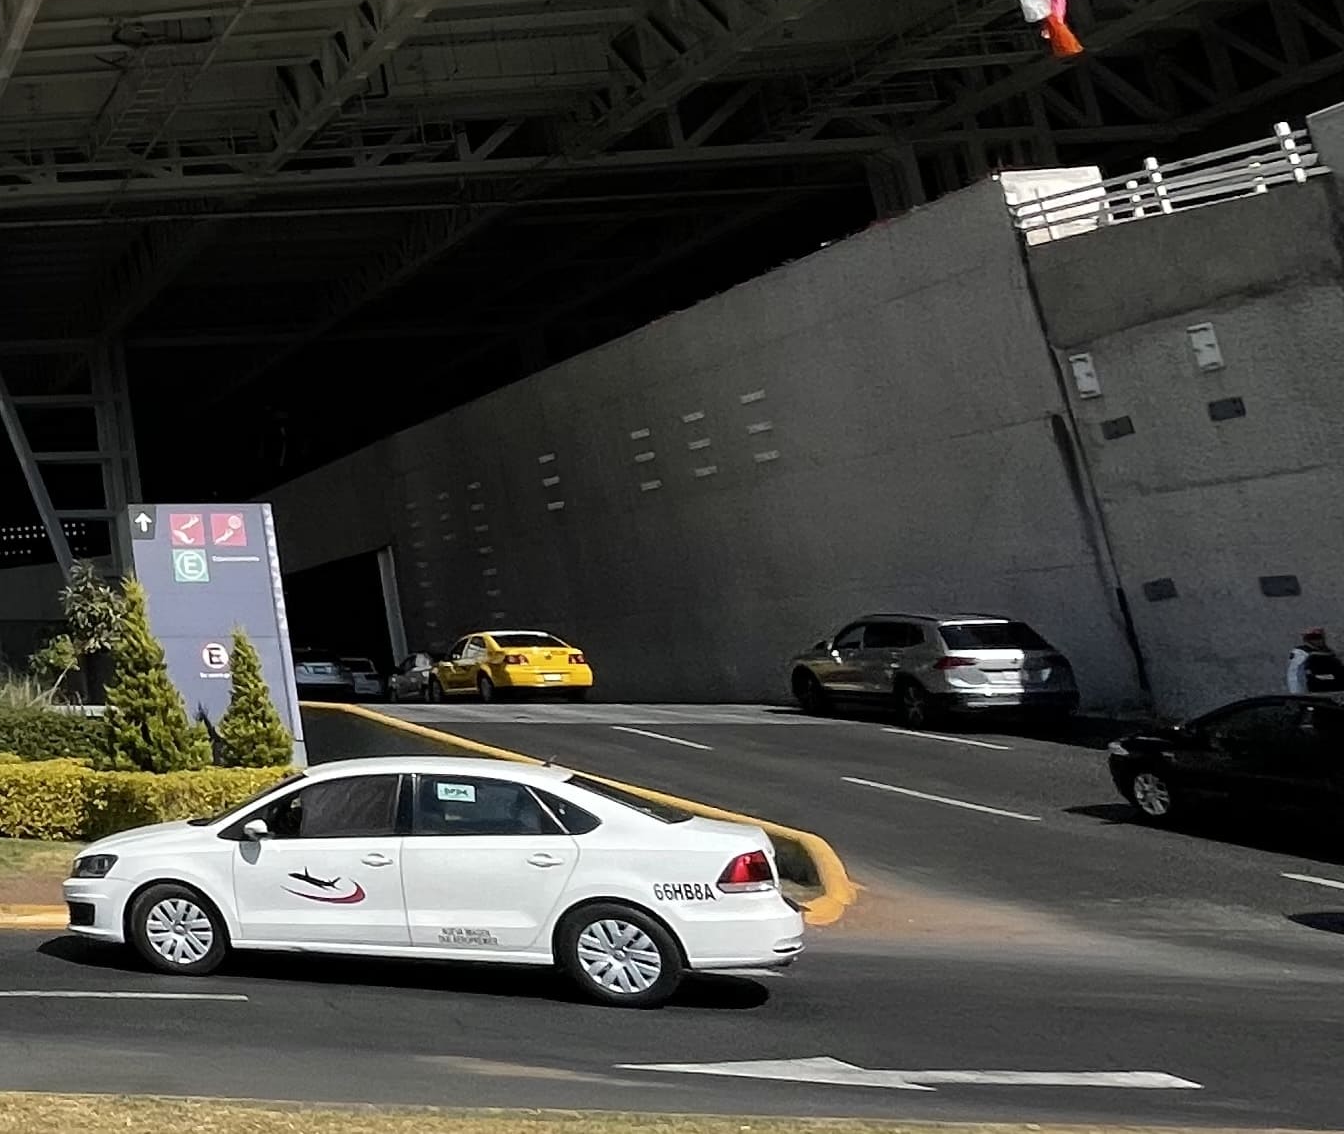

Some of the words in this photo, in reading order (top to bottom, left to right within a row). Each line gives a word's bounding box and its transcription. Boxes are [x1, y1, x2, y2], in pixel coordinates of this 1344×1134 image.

[183, 555, 199, 574] E
[206, 647, 224, 665] E
[652, 883, 717, 901] 66HB8A
